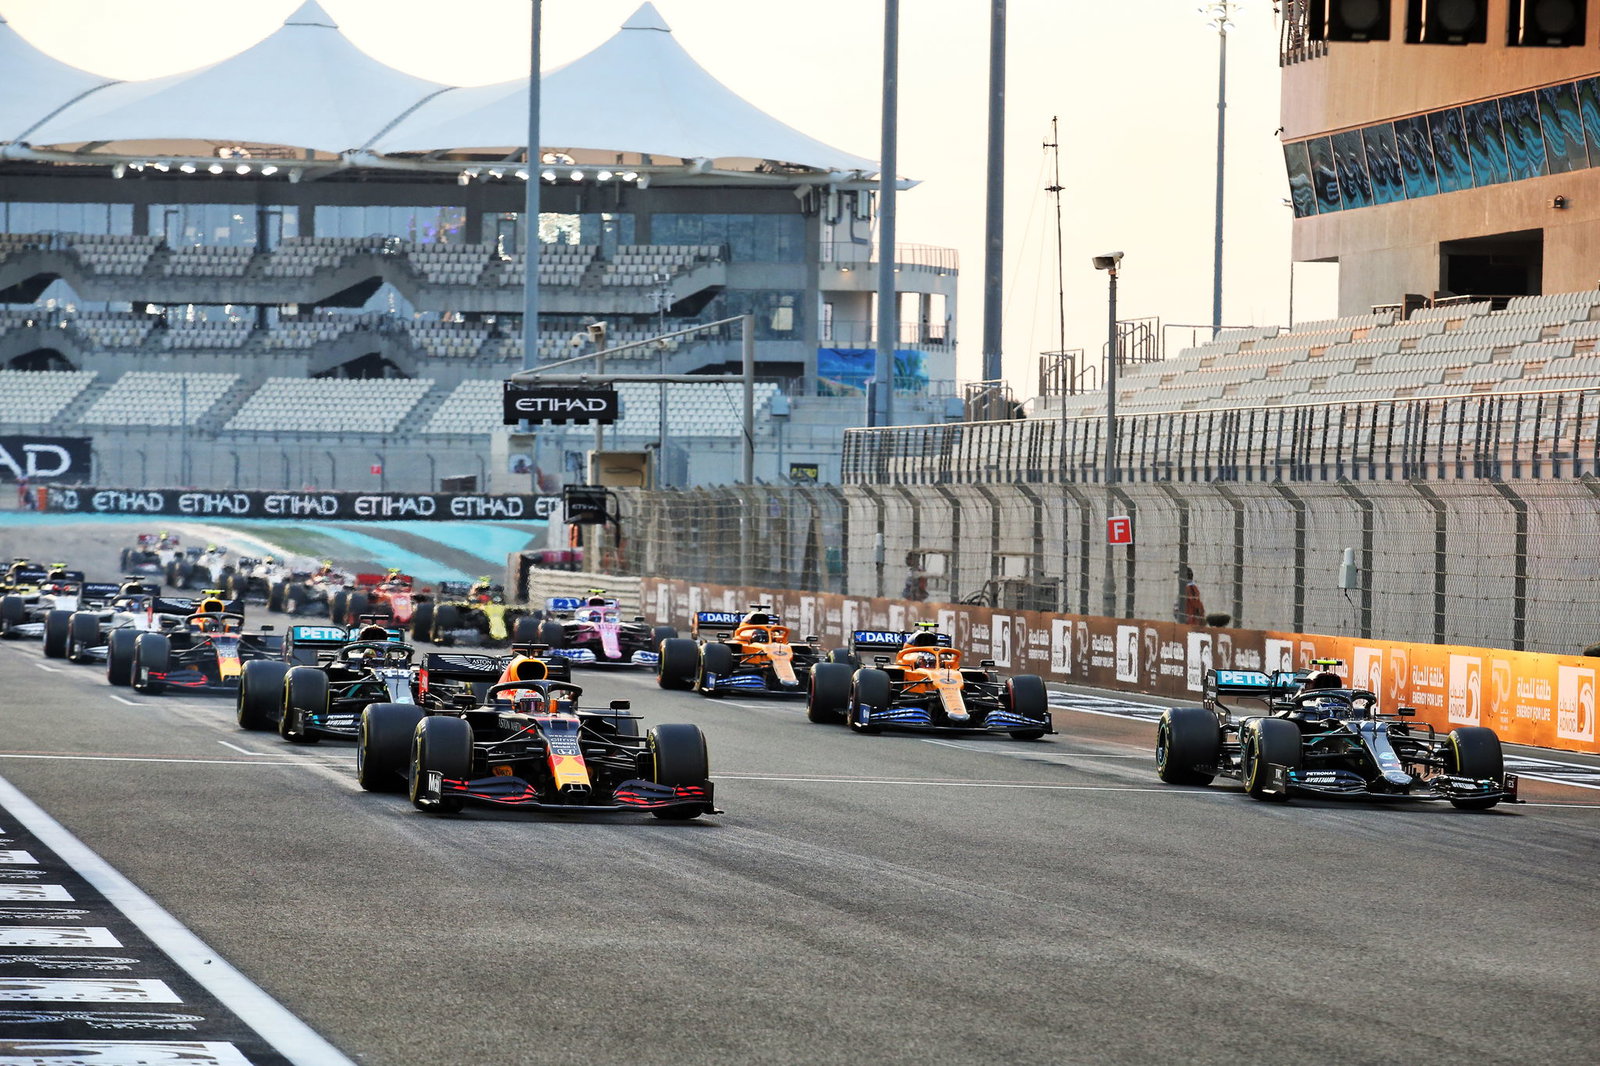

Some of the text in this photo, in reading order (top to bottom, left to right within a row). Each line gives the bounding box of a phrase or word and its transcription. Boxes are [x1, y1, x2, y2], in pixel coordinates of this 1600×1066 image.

[516, 398, 607, 412] ETIHAD
[92, 491, 164, 512] ETIHAD
[178, 492, 250, 514] ETIHAD
[263, 494, 338, 516] ETIHAD
[354, 495, 436, 517] ETIHAD
[450, 496, 523, 517] ETIHAD
[1113, 522, 1125, 541] F
[707, 613, 738, 623] DARK
[865, 632, 903, 643] DARK
